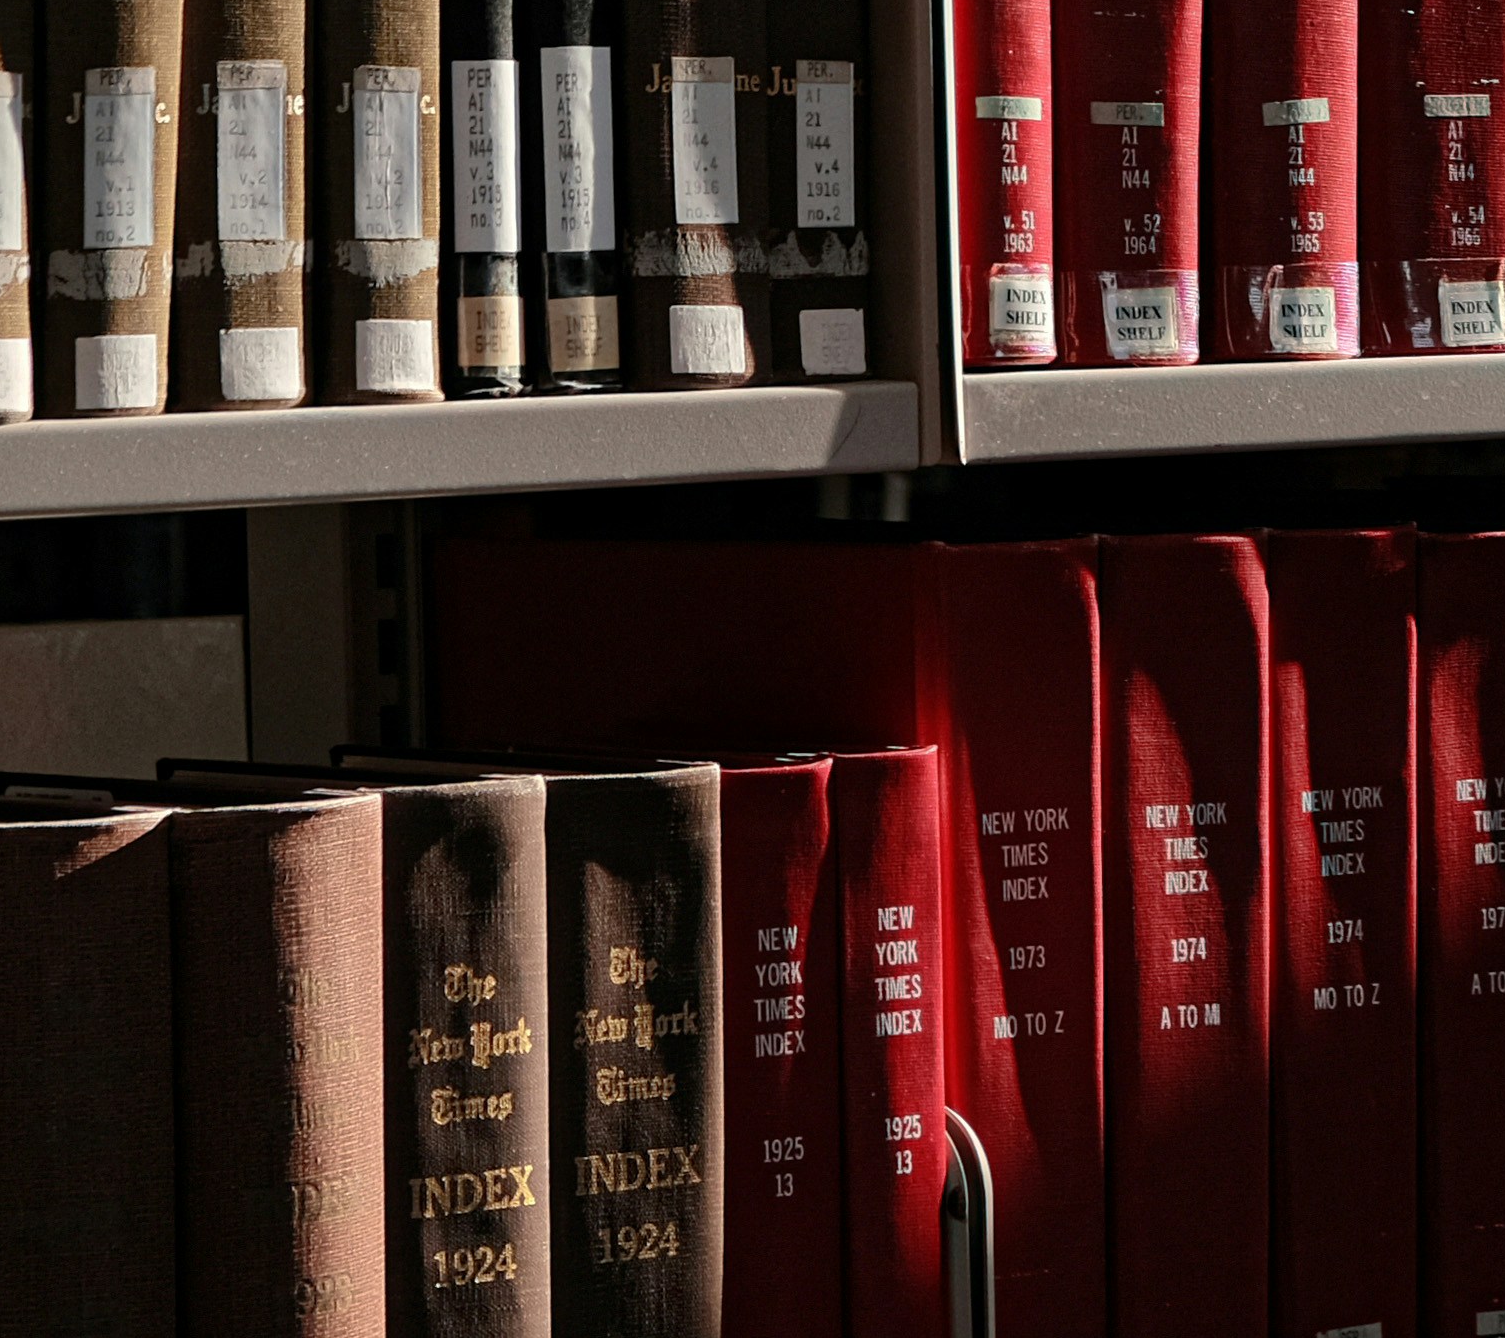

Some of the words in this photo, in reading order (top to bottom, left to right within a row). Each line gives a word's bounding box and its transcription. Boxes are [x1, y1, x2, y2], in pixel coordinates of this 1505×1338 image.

[1123, 218, 1136, 234] v.
[1144, 214, 1161, 234] 52
[1124, 235, 1156, 254] 1964
[1116, 306, 1161, 319] INDEX
[982, 811, 1015, 835] NEW
[1024, 808, 1069, 832] YORK
[1001, 842, 1049, 867] TIMES
[1003, 876, 1049, 901] INDEX
[877, 906, 913, 931] NEW
[875, 940, 918, 966] YORK
[1009, 945, 1045, 970] 1973
[444, 963, 496, 1005] The
[874, 974, 922, 1001] TIMES
[876, 1009, 922, 1037] INDEX
[993, 1015, 1018, 1038] MO
[1025, 1012, 1046, 1036] TO
[1055, 1010, 1064, 1033] Z
[885, 1115, 921, 1141] 1925
[896, 1150, 913, 1174] 13
[409, 1166, 534, 1219] INDEX
[434, 1244, 516, 1288] 1924
